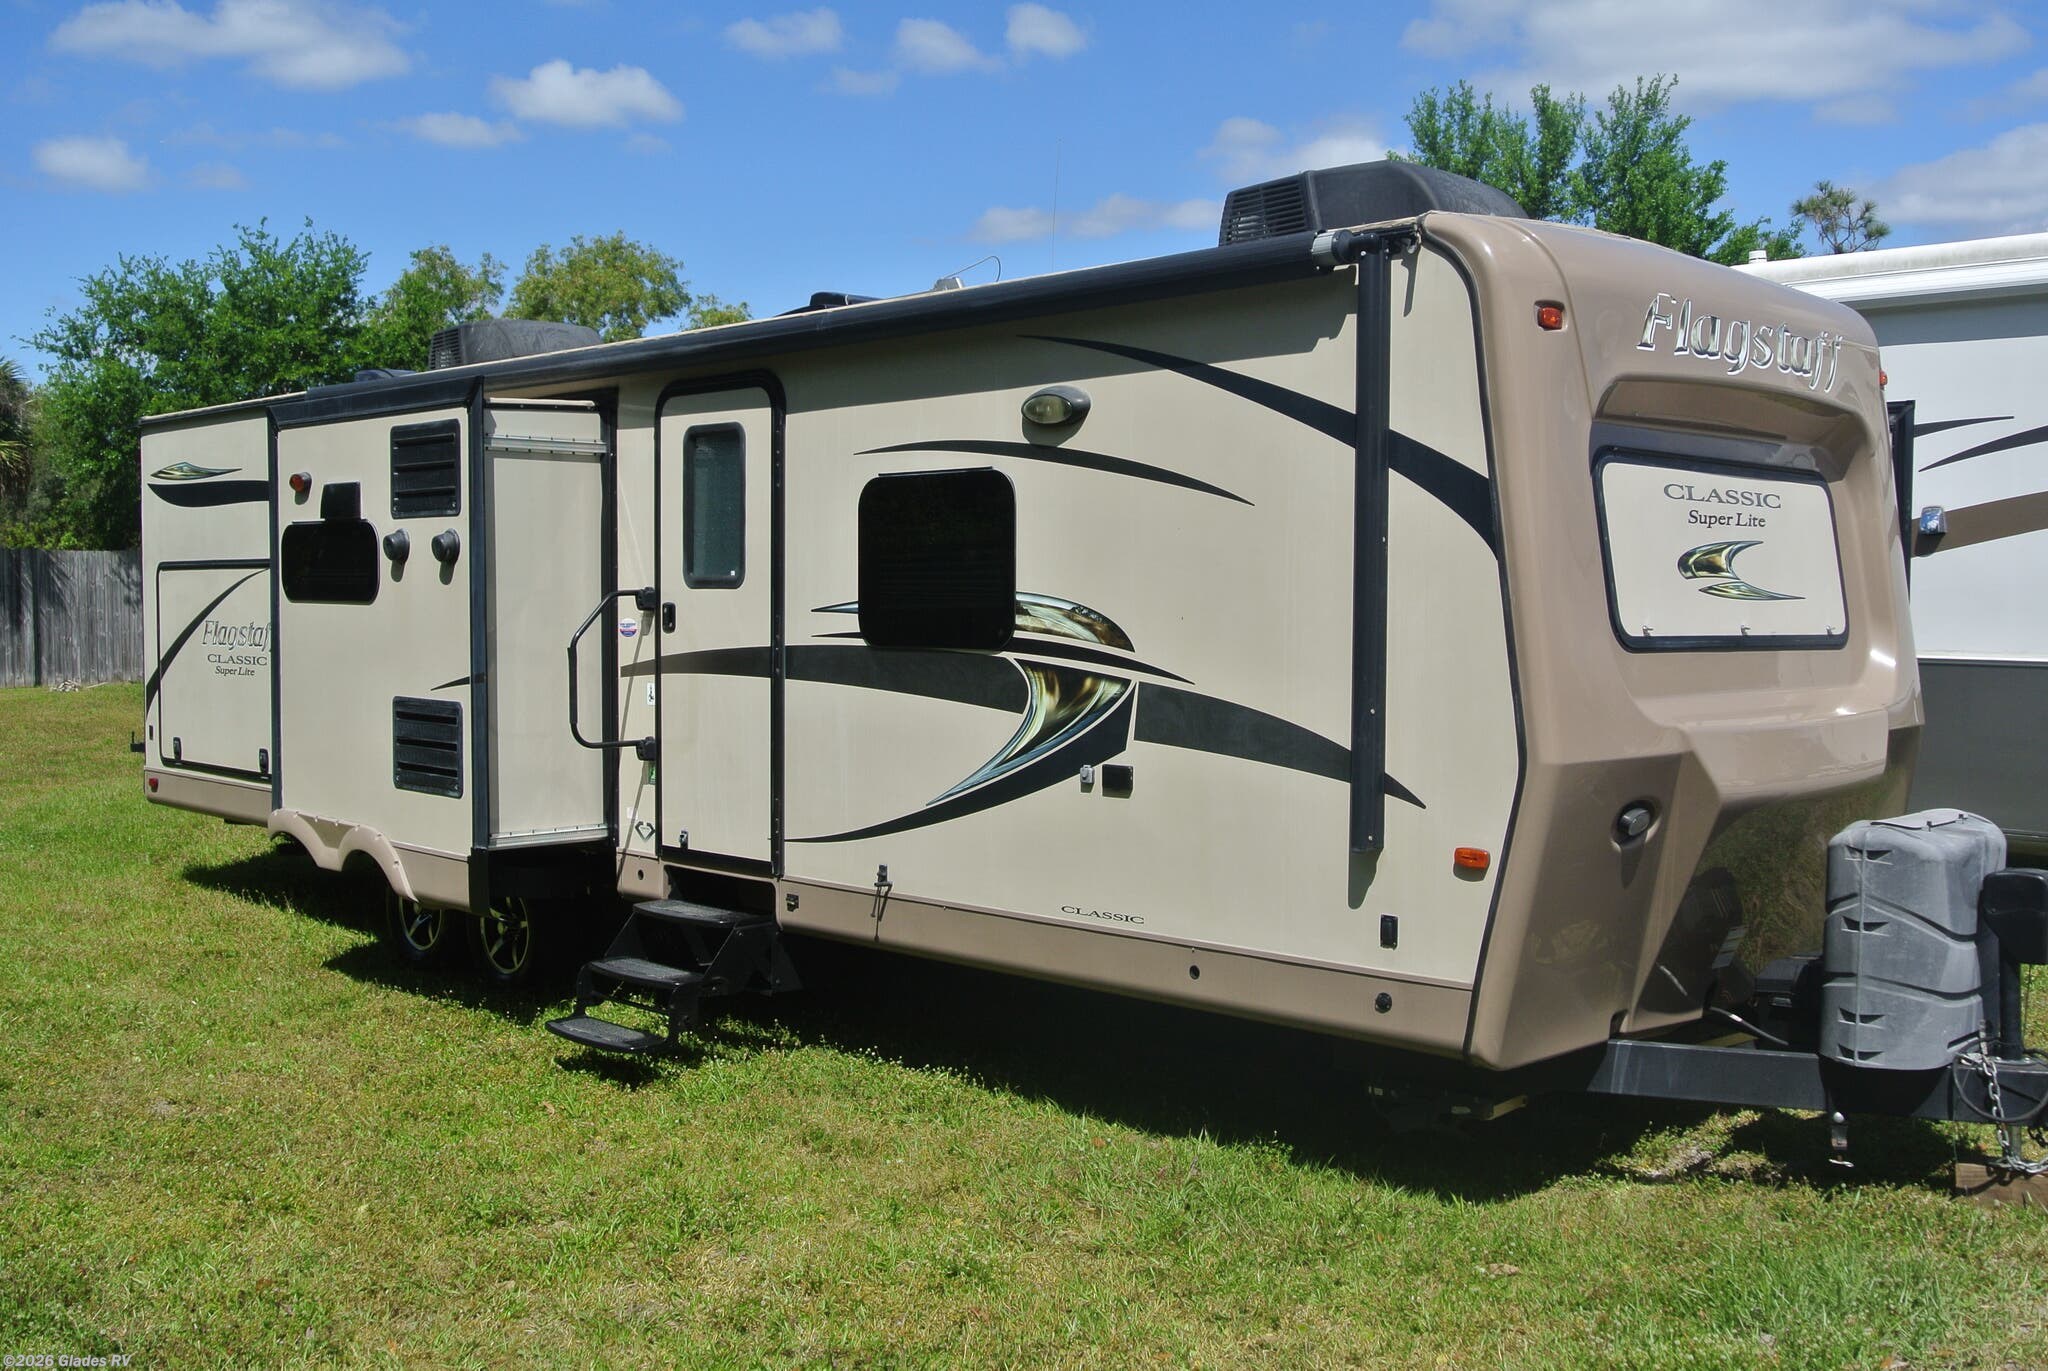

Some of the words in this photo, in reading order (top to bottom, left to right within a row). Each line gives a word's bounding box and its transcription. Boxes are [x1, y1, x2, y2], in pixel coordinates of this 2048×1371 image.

[1636, 292, 1844, 394] Flagstaff
[1663, 483, 1782, 509] CLASSIC
[1687, 509, 1733, 529] Super
[1735, 512, 1767, 528] Lite
[202, 620, 271, 652] Flagstaf
[207, 653, 268, 666] CLASSIC
[215, 665, 237, 676] Super
[237, 666, 255, 676] Lite
[1061, 905, 1145, 924] CLASSIC
